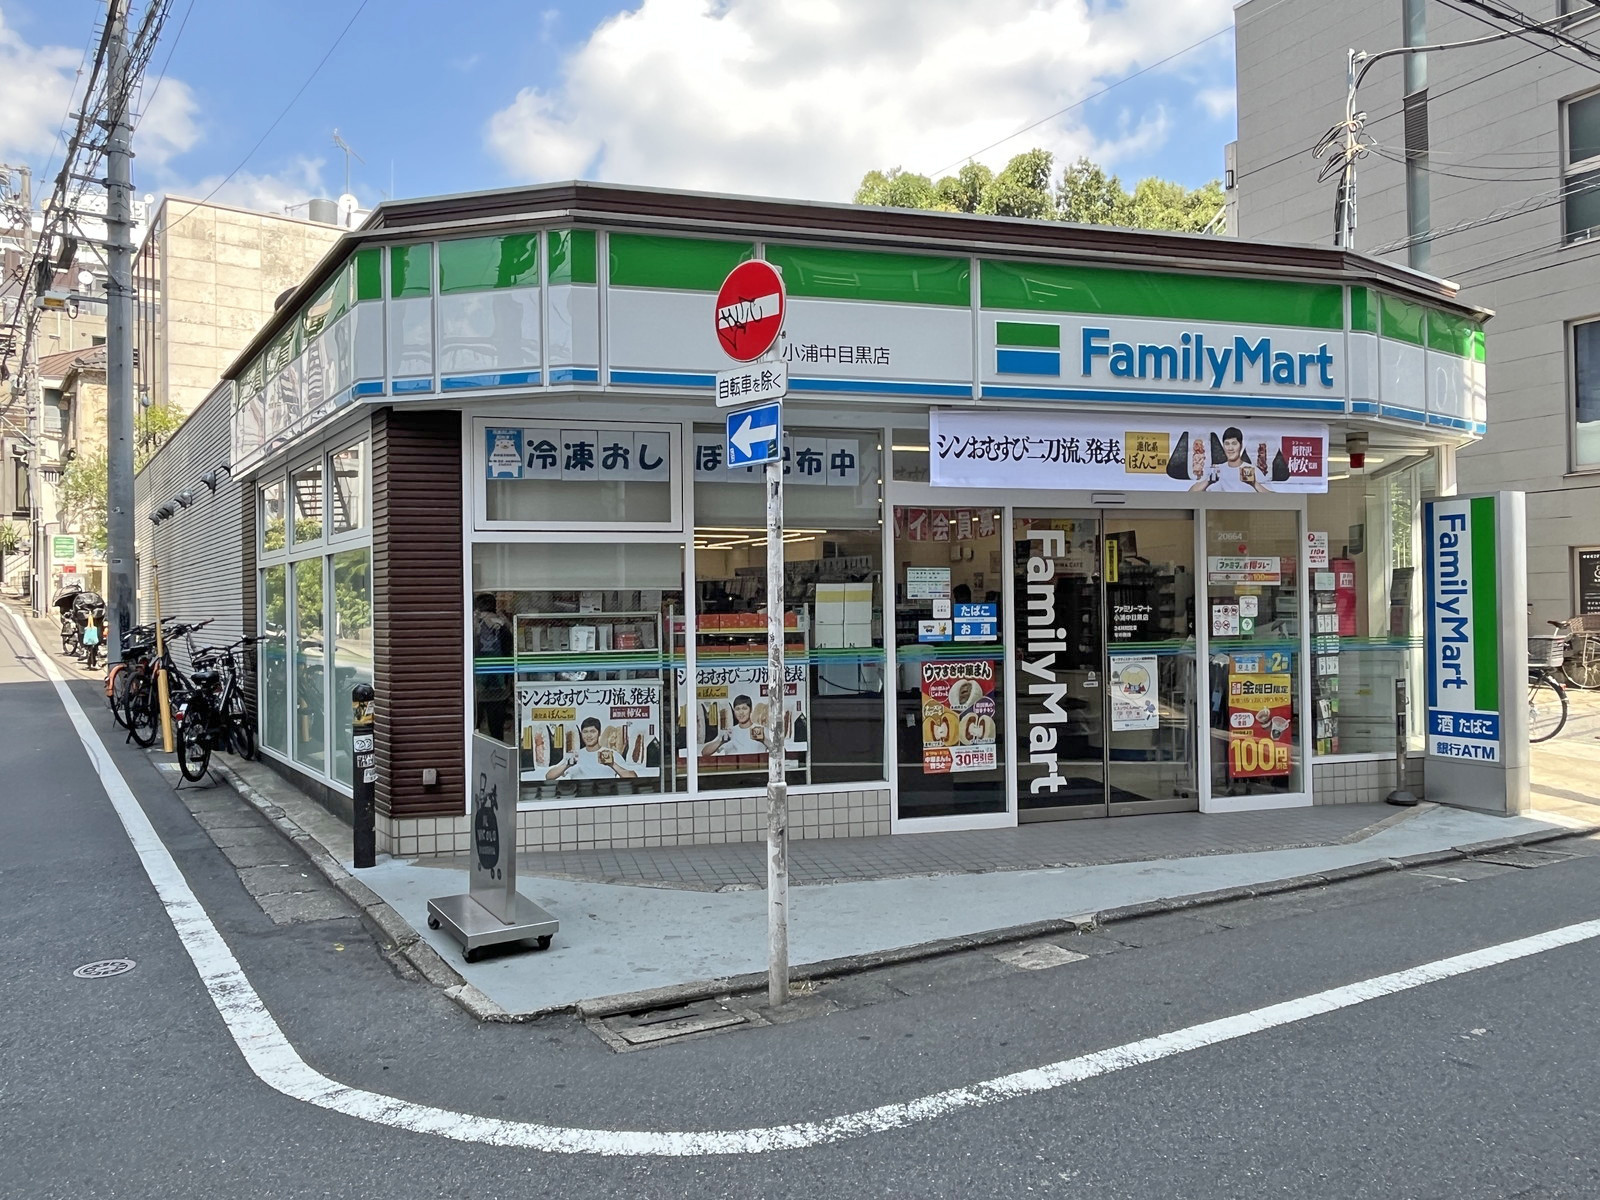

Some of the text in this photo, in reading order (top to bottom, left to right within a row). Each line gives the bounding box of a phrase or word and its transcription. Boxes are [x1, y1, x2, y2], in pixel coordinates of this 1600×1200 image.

[783, 343, 889, 365] 小浦中目黒店
[1081, 326, 1334, 389] FamilyMart
[719, 370, 781, 399] 自転車を除く
[937, 434, 1126, 466] シンおむすび二刀流、発表。
[961, 605, 990, 617] たばこ
[1114, 605, 1152, 613] ファミリーマート
[1436, 514, 1469, 690] FamilyMart
[924, 662, 992, 682] ウマすぎ中華まん
[1022, 530, 1068, 794] FamilyMart
[522, 688, 660, 706] シンおむすび二刀流、発表。
[1243, 681, 1288, 694] 金曜日限定
[1438, 715, 1493, 735] 酒 たばこ
[1436, 741, 1495, 760] 銀行ATM
